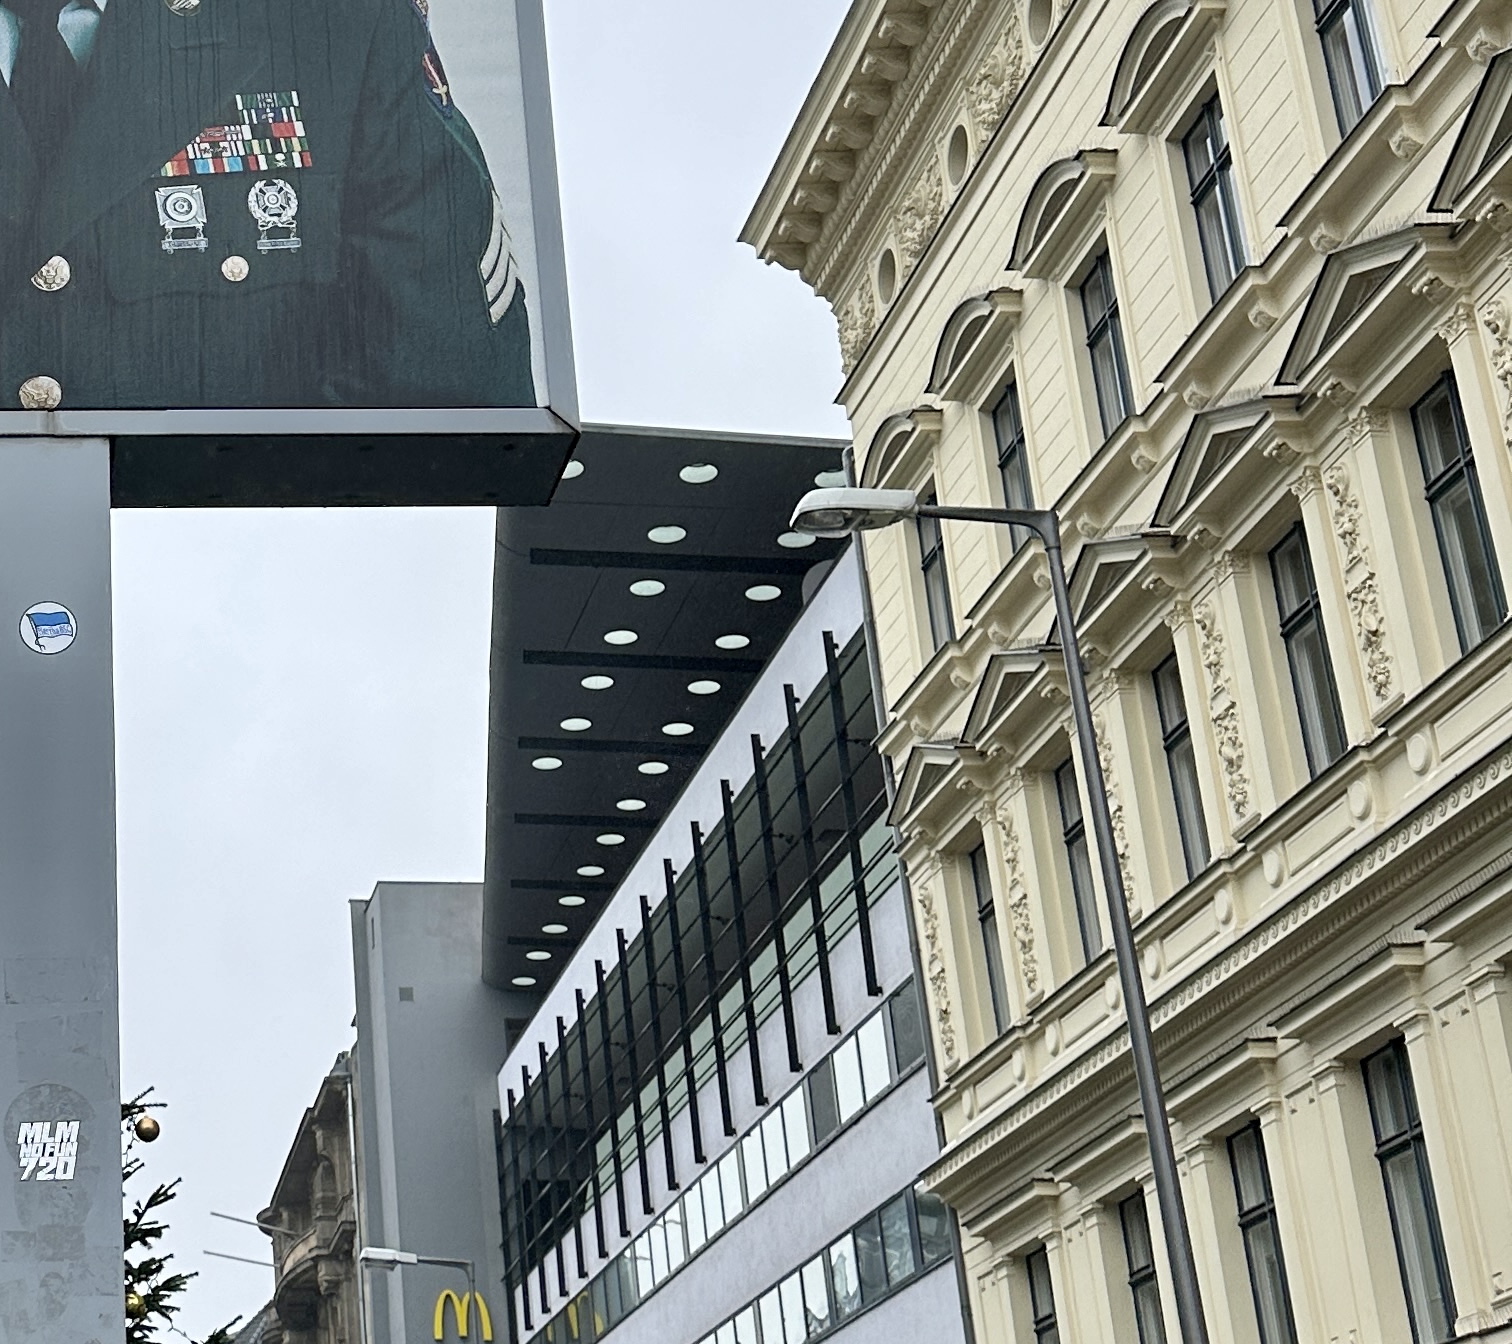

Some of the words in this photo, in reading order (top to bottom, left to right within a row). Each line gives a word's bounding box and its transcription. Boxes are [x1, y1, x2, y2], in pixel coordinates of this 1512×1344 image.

[18, 1120, 81, 1145] MLM
[20, 1143, 43, 1158] NO
[44, 1141, 79, 1158] FUN
[19, 1156, 76, 1182] 720
